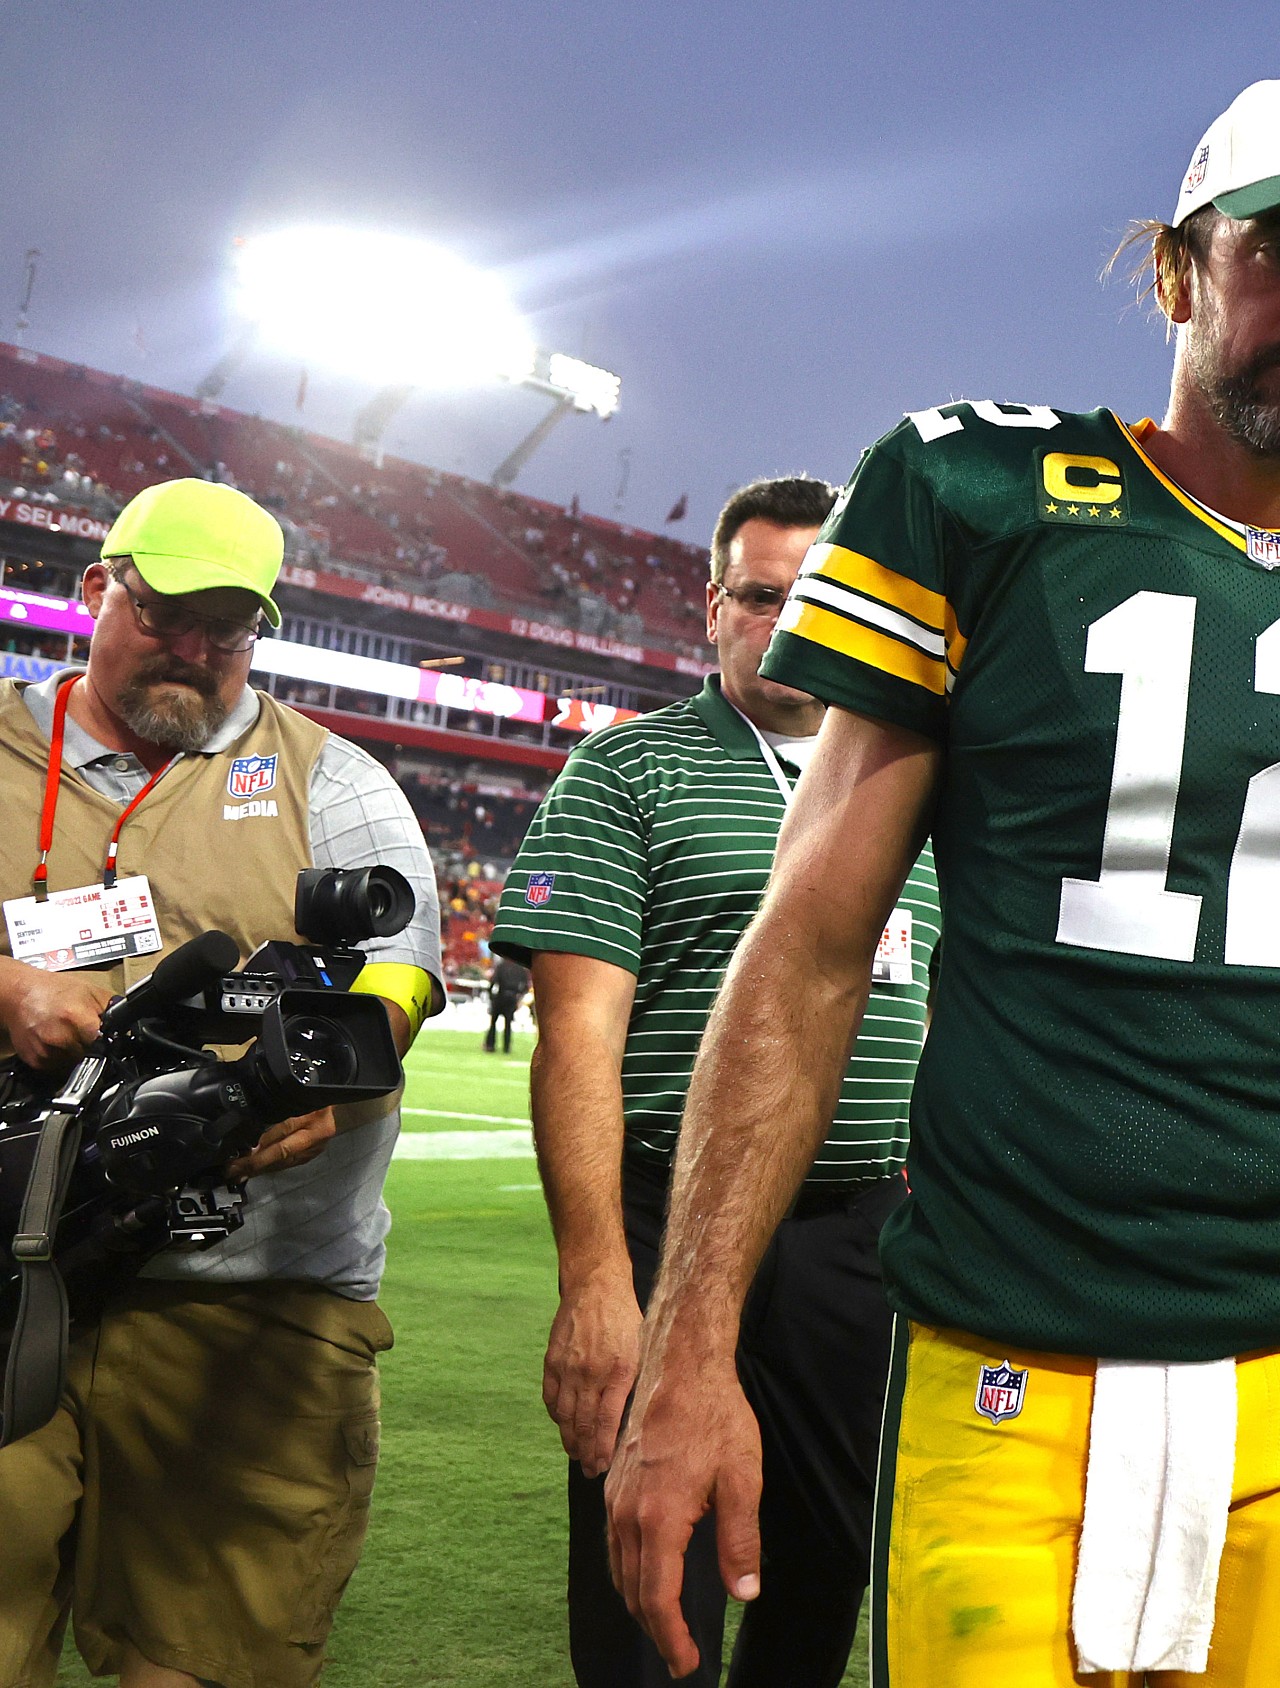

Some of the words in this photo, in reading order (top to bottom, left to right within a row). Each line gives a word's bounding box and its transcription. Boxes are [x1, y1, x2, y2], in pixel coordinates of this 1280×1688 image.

[1043, 452, 1122, 504] C
[0, 501, 11, 517] Y
[16, 502, 107, 538] SELMON
[234, 771, 268, 793] NFL
[223, 799, 279, 821] MEDIA
[528, 886, 549, 902] NFL
[110, 1125, 160, 1149] FUJINON
[982, 1387, 1015, 1413] NFL
